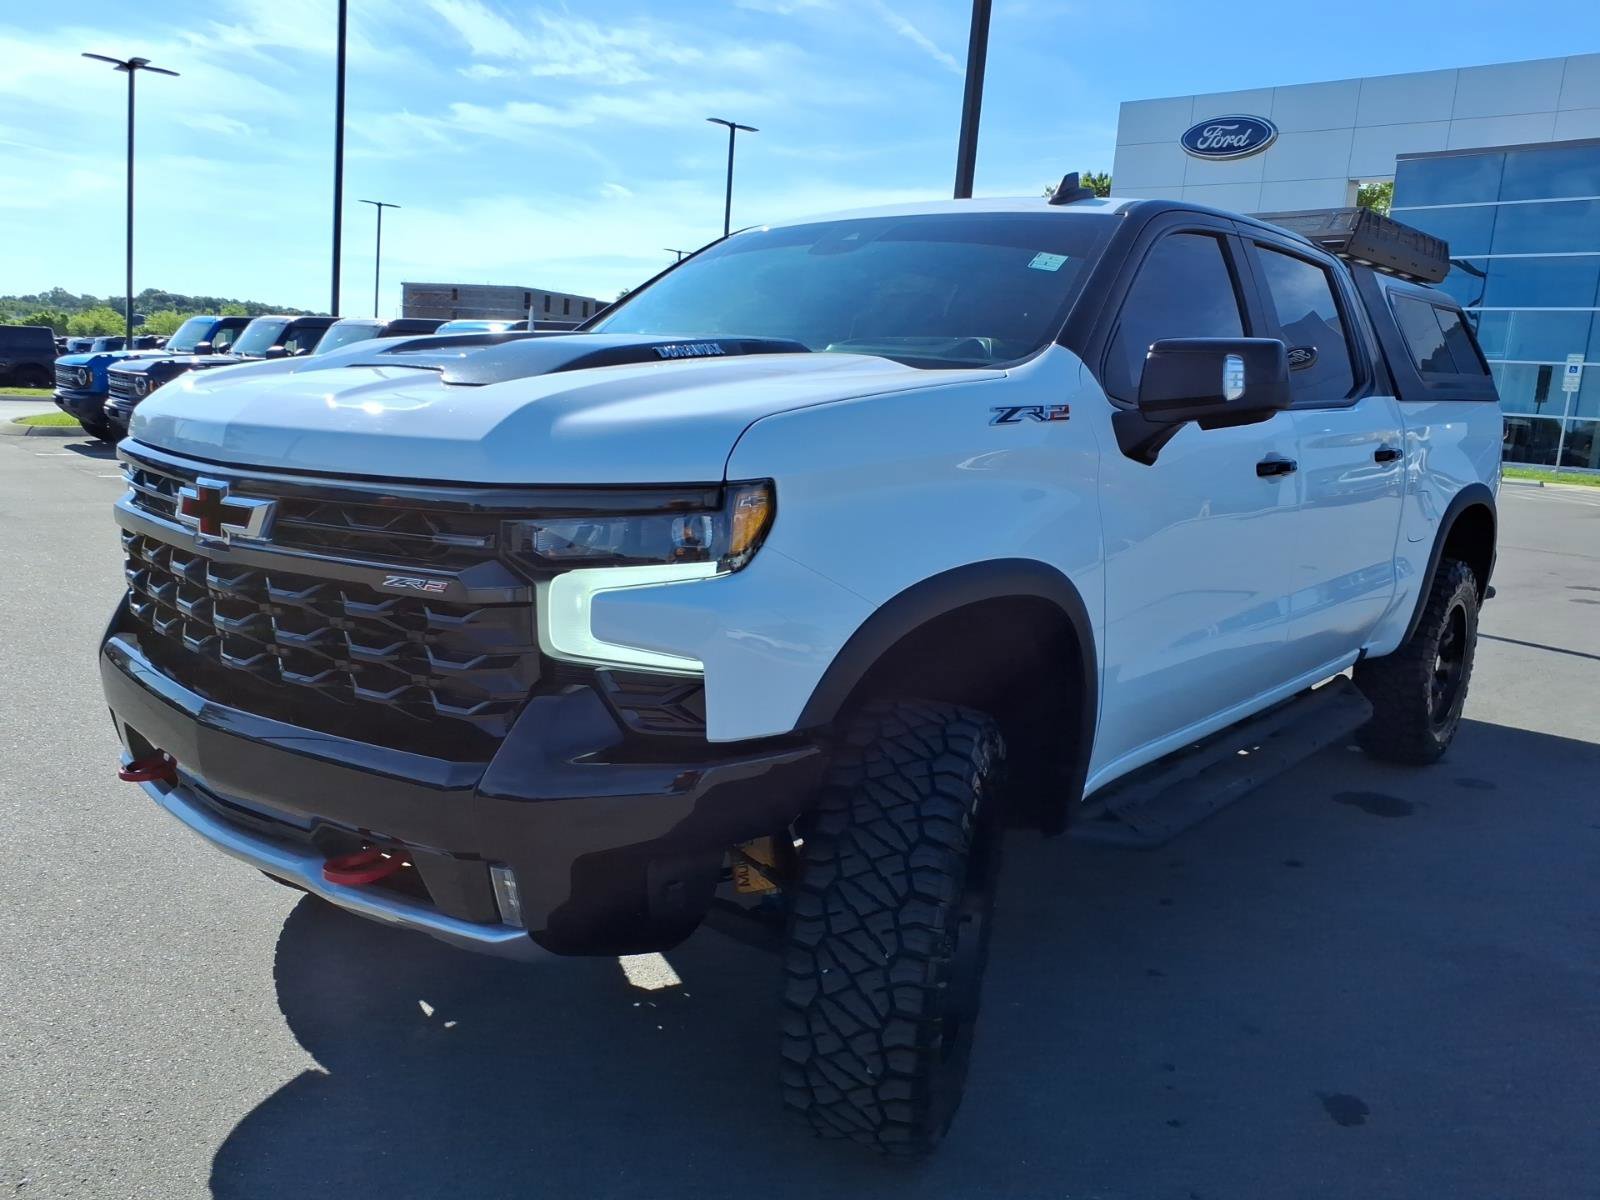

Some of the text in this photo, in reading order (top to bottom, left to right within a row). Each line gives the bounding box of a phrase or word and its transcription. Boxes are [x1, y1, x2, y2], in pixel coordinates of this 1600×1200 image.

[1197, 124, 1252, 149] Ford
[989, 404, 1070, 426] ZR2
[383, 575, 449, 592] ZR2
